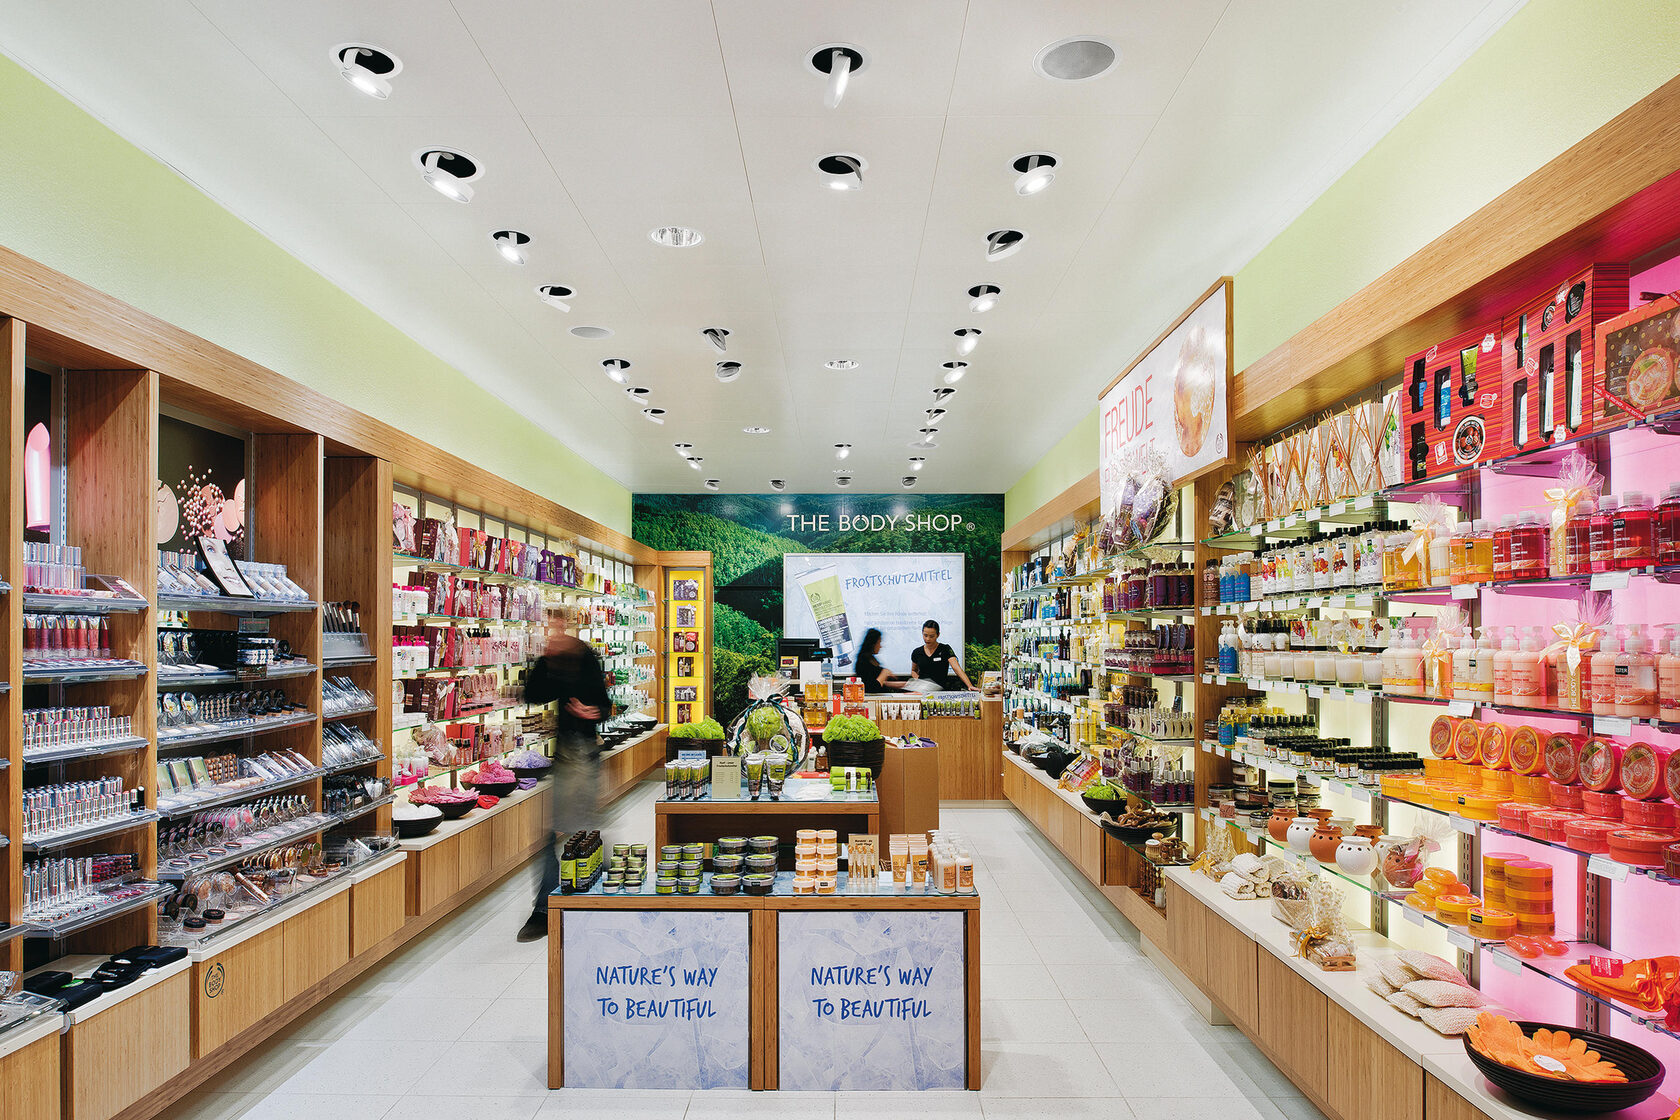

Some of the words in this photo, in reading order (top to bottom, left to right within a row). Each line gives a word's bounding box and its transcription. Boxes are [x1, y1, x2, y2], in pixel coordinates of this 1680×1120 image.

[1104, 374, 1153, 458] FREUDE
[786, 514, 830, 532] THE
[839, 514, 900, 532] BODY
[845, 569, 953, 590] FROSTSCHUTZMITTEL
[596, 965, 676, 987] NATURE'S
[683, 967, 718, 987] WAY
[811, 964, 891, 987] NATURE'S
[898, 966, 933, 987] WAY
[597, 997, 619, 1017] TO
[625, 997, 717, 1021] BEAUTIFUL
[812, 997, 835, 1018] TO
[840, 997, 932, 1021] BEAUTIFUL
